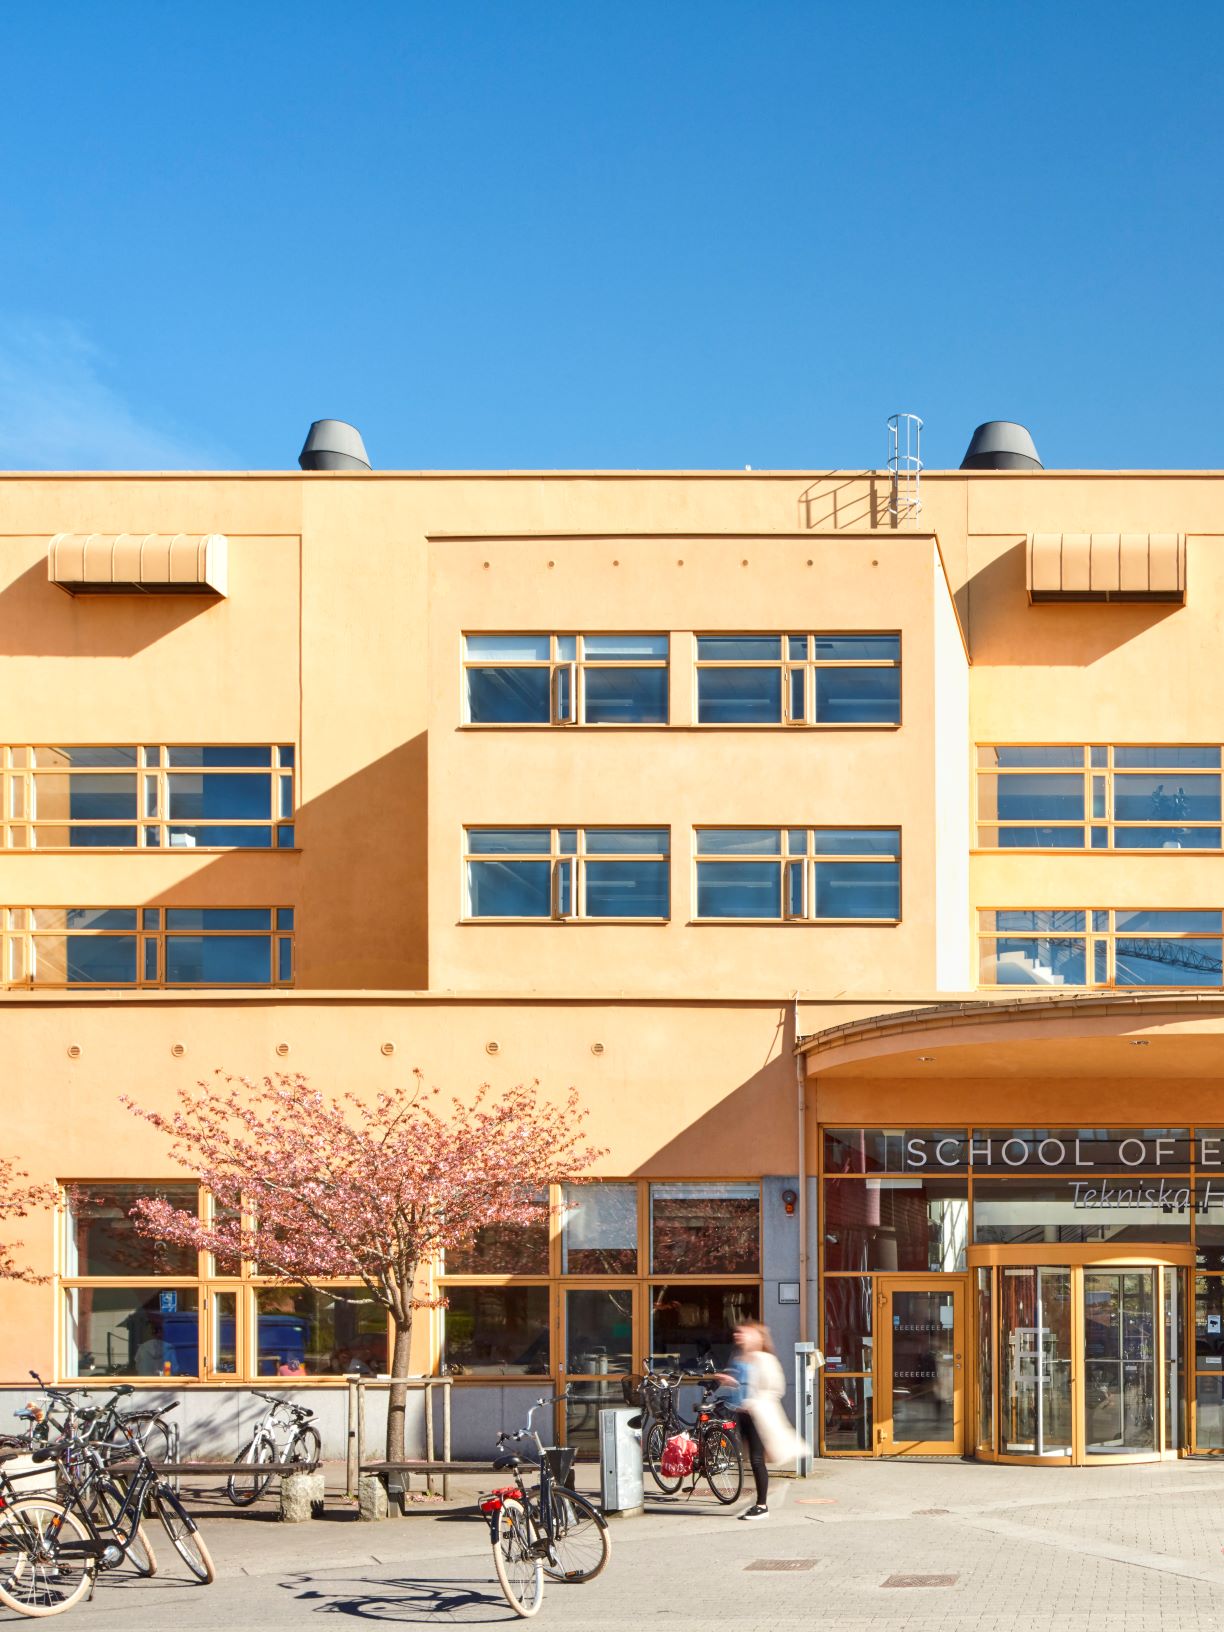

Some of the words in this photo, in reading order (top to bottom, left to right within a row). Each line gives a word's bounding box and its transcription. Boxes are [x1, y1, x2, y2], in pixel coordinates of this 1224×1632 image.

[906, 1138, 1095, 1166] SCHOOL
[1118, 1138, 1176, 1166] OF
[1068, 1178, 1191, 1209] Tekniska
